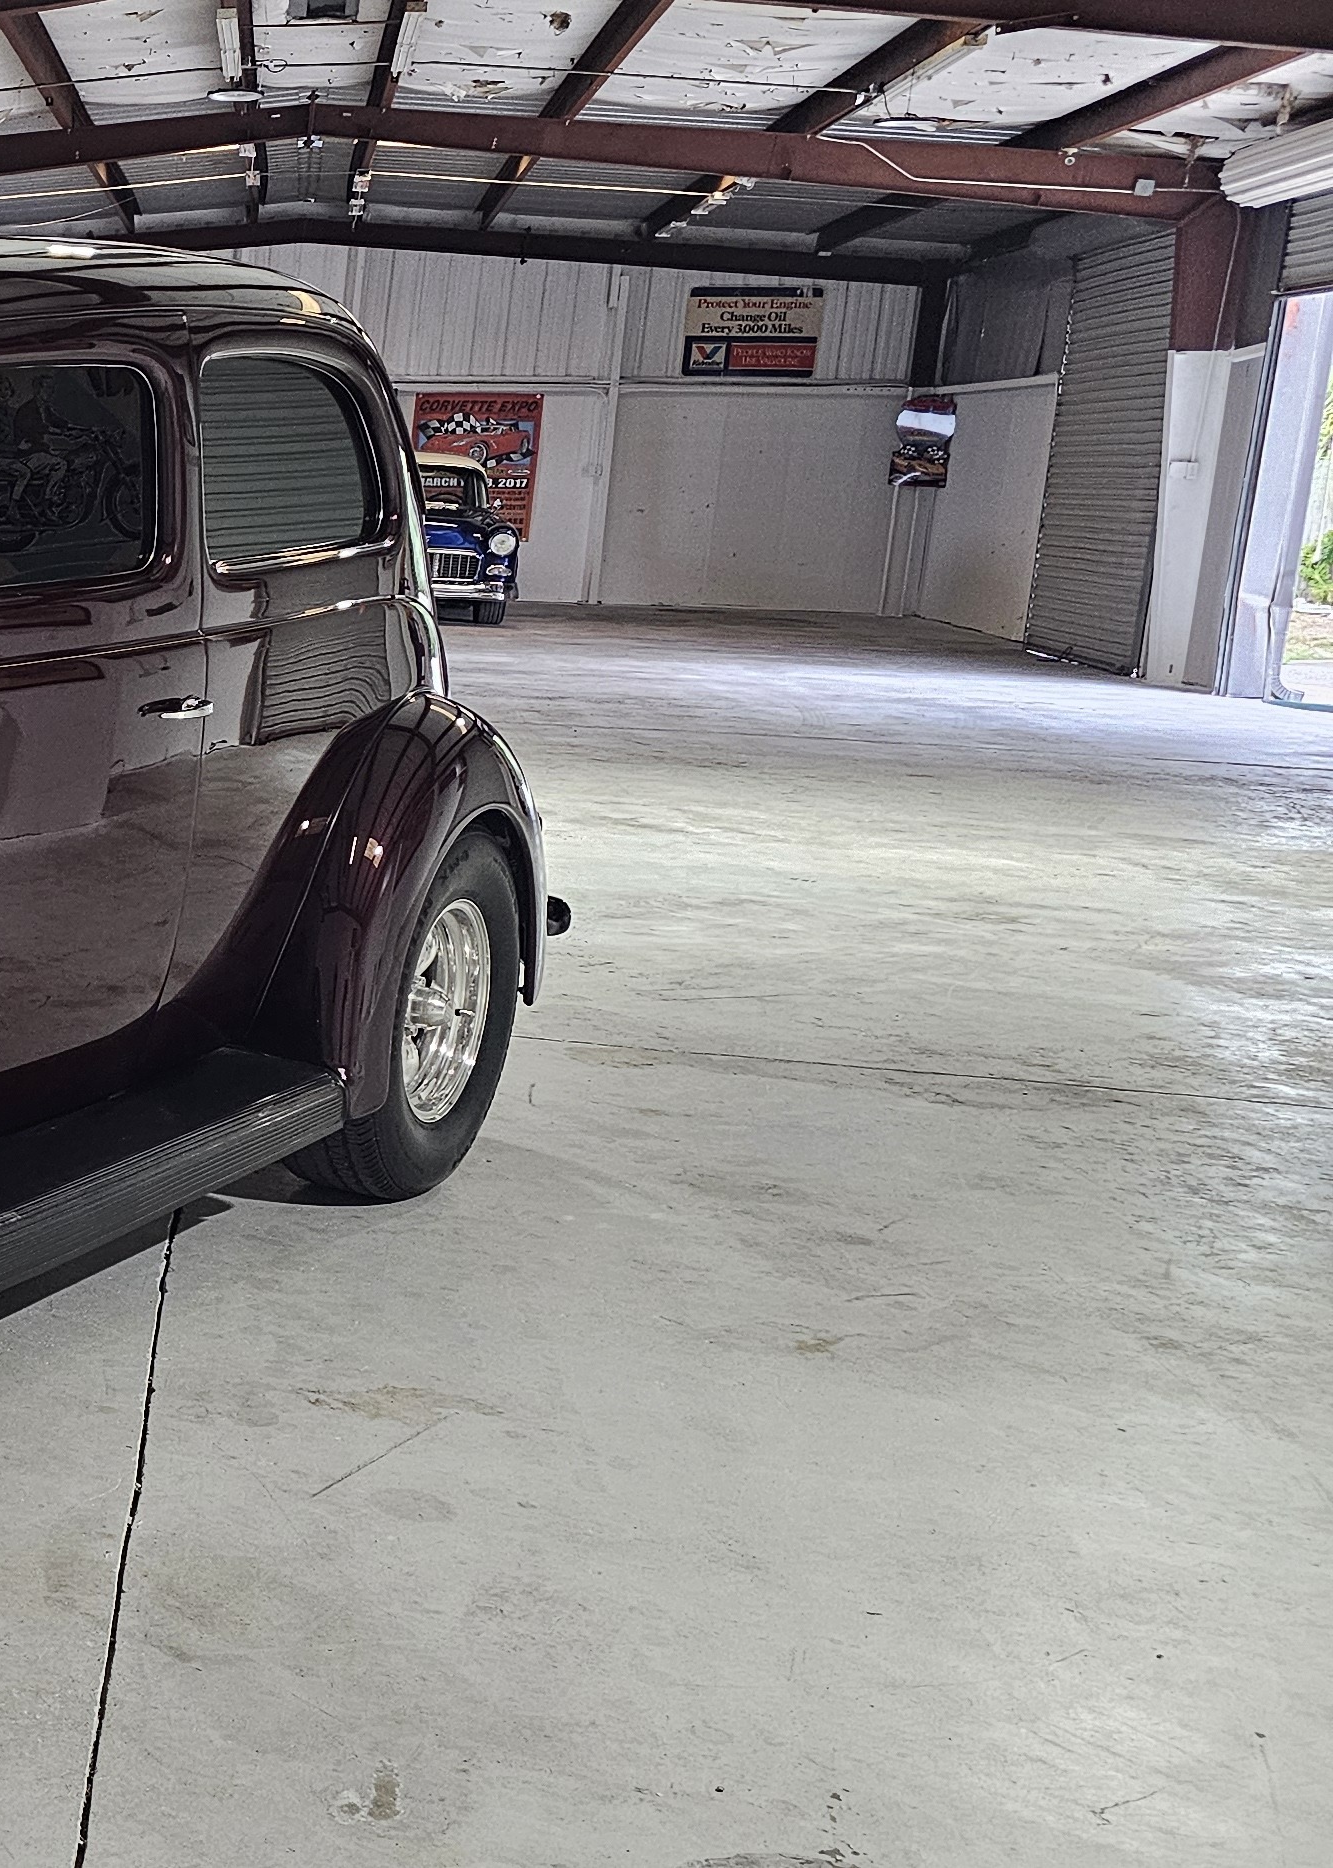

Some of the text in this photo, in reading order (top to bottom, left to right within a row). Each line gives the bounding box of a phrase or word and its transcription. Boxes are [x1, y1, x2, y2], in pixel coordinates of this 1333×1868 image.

[697, 299, 813, 310] Protect Your Engine
[720, 311, 787, 323] Change Oil
[701, 323, 734, 335] Every
[769, 324, 804, 334] Miles
[420, 400, 539, 413] CORVETTE EXPO
[497, 478, 528, 488] 2017
